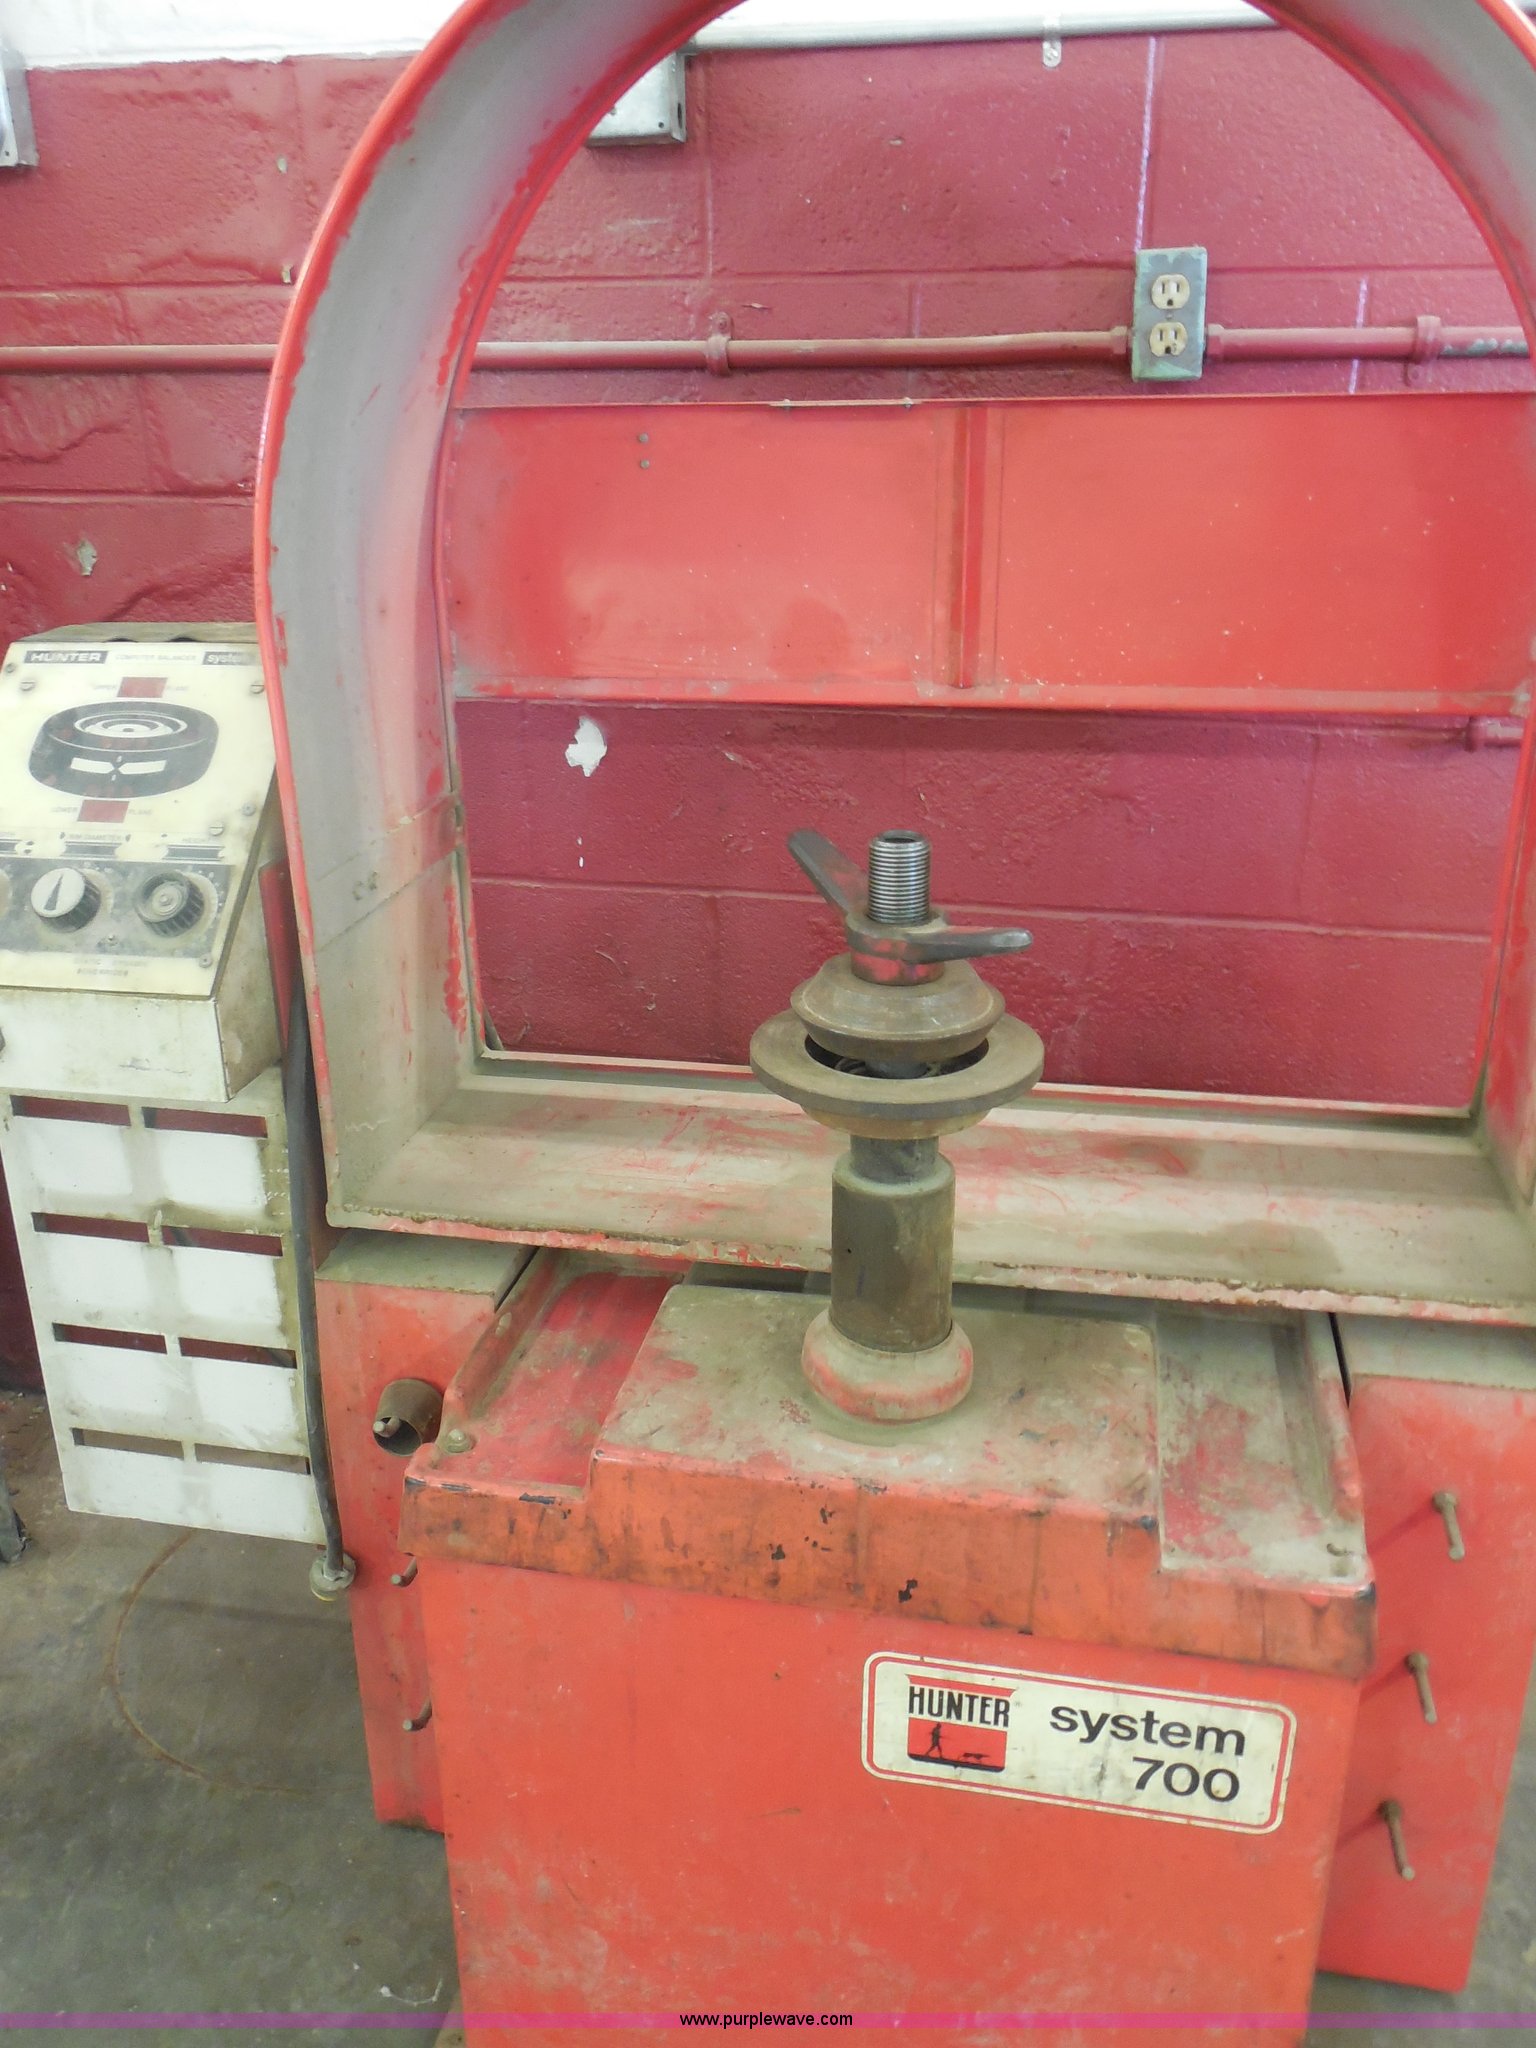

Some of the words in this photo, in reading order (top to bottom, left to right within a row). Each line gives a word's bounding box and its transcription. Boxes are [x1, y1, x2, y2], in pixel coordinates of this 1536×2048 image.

[30, 652, 102, 662] HUNTER
[907, 1685, 1012, 1728] HUNTER
[1050, 1703, 1246, 1757] system
[1132, 1756, 1241, 1803] 700
